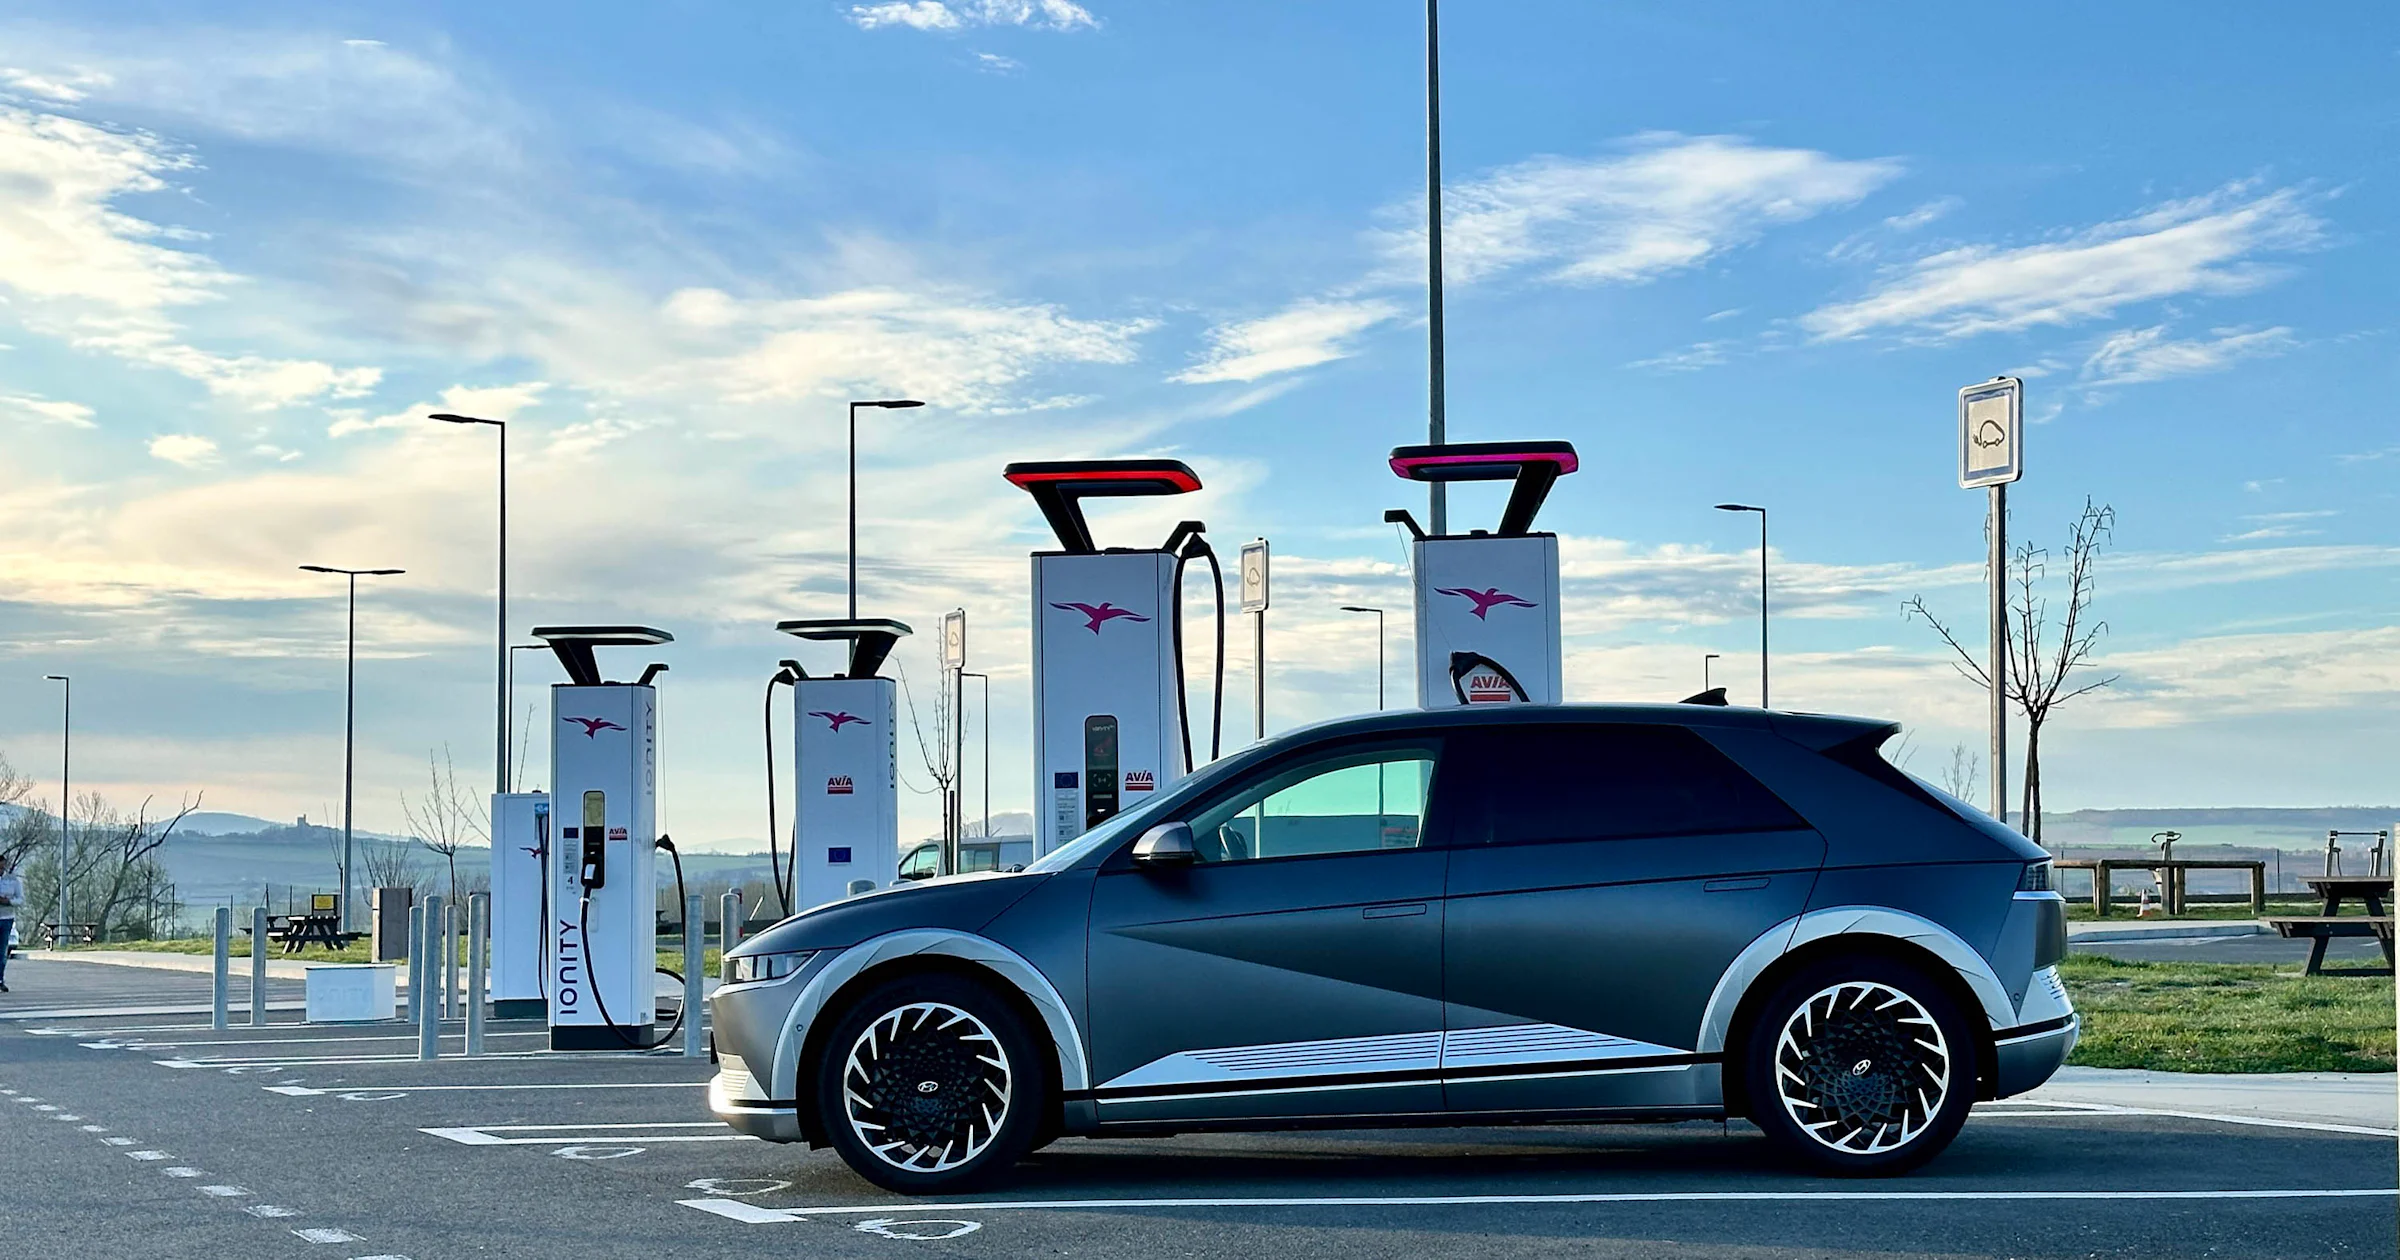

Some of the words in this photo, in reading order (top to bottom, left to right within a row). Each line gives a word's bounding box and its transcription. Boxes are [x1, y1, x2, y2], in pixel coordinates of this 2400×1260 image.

[645, 701, 653, 795] IONITY
[828, 775, 853, 786] AVIA
[1125, 770, 1154, 781] AVIA
[609, 827, 628, 835] AVIA
[567, 876, 574, 885] 4
[559, 919, 578, 1014] IONITY
